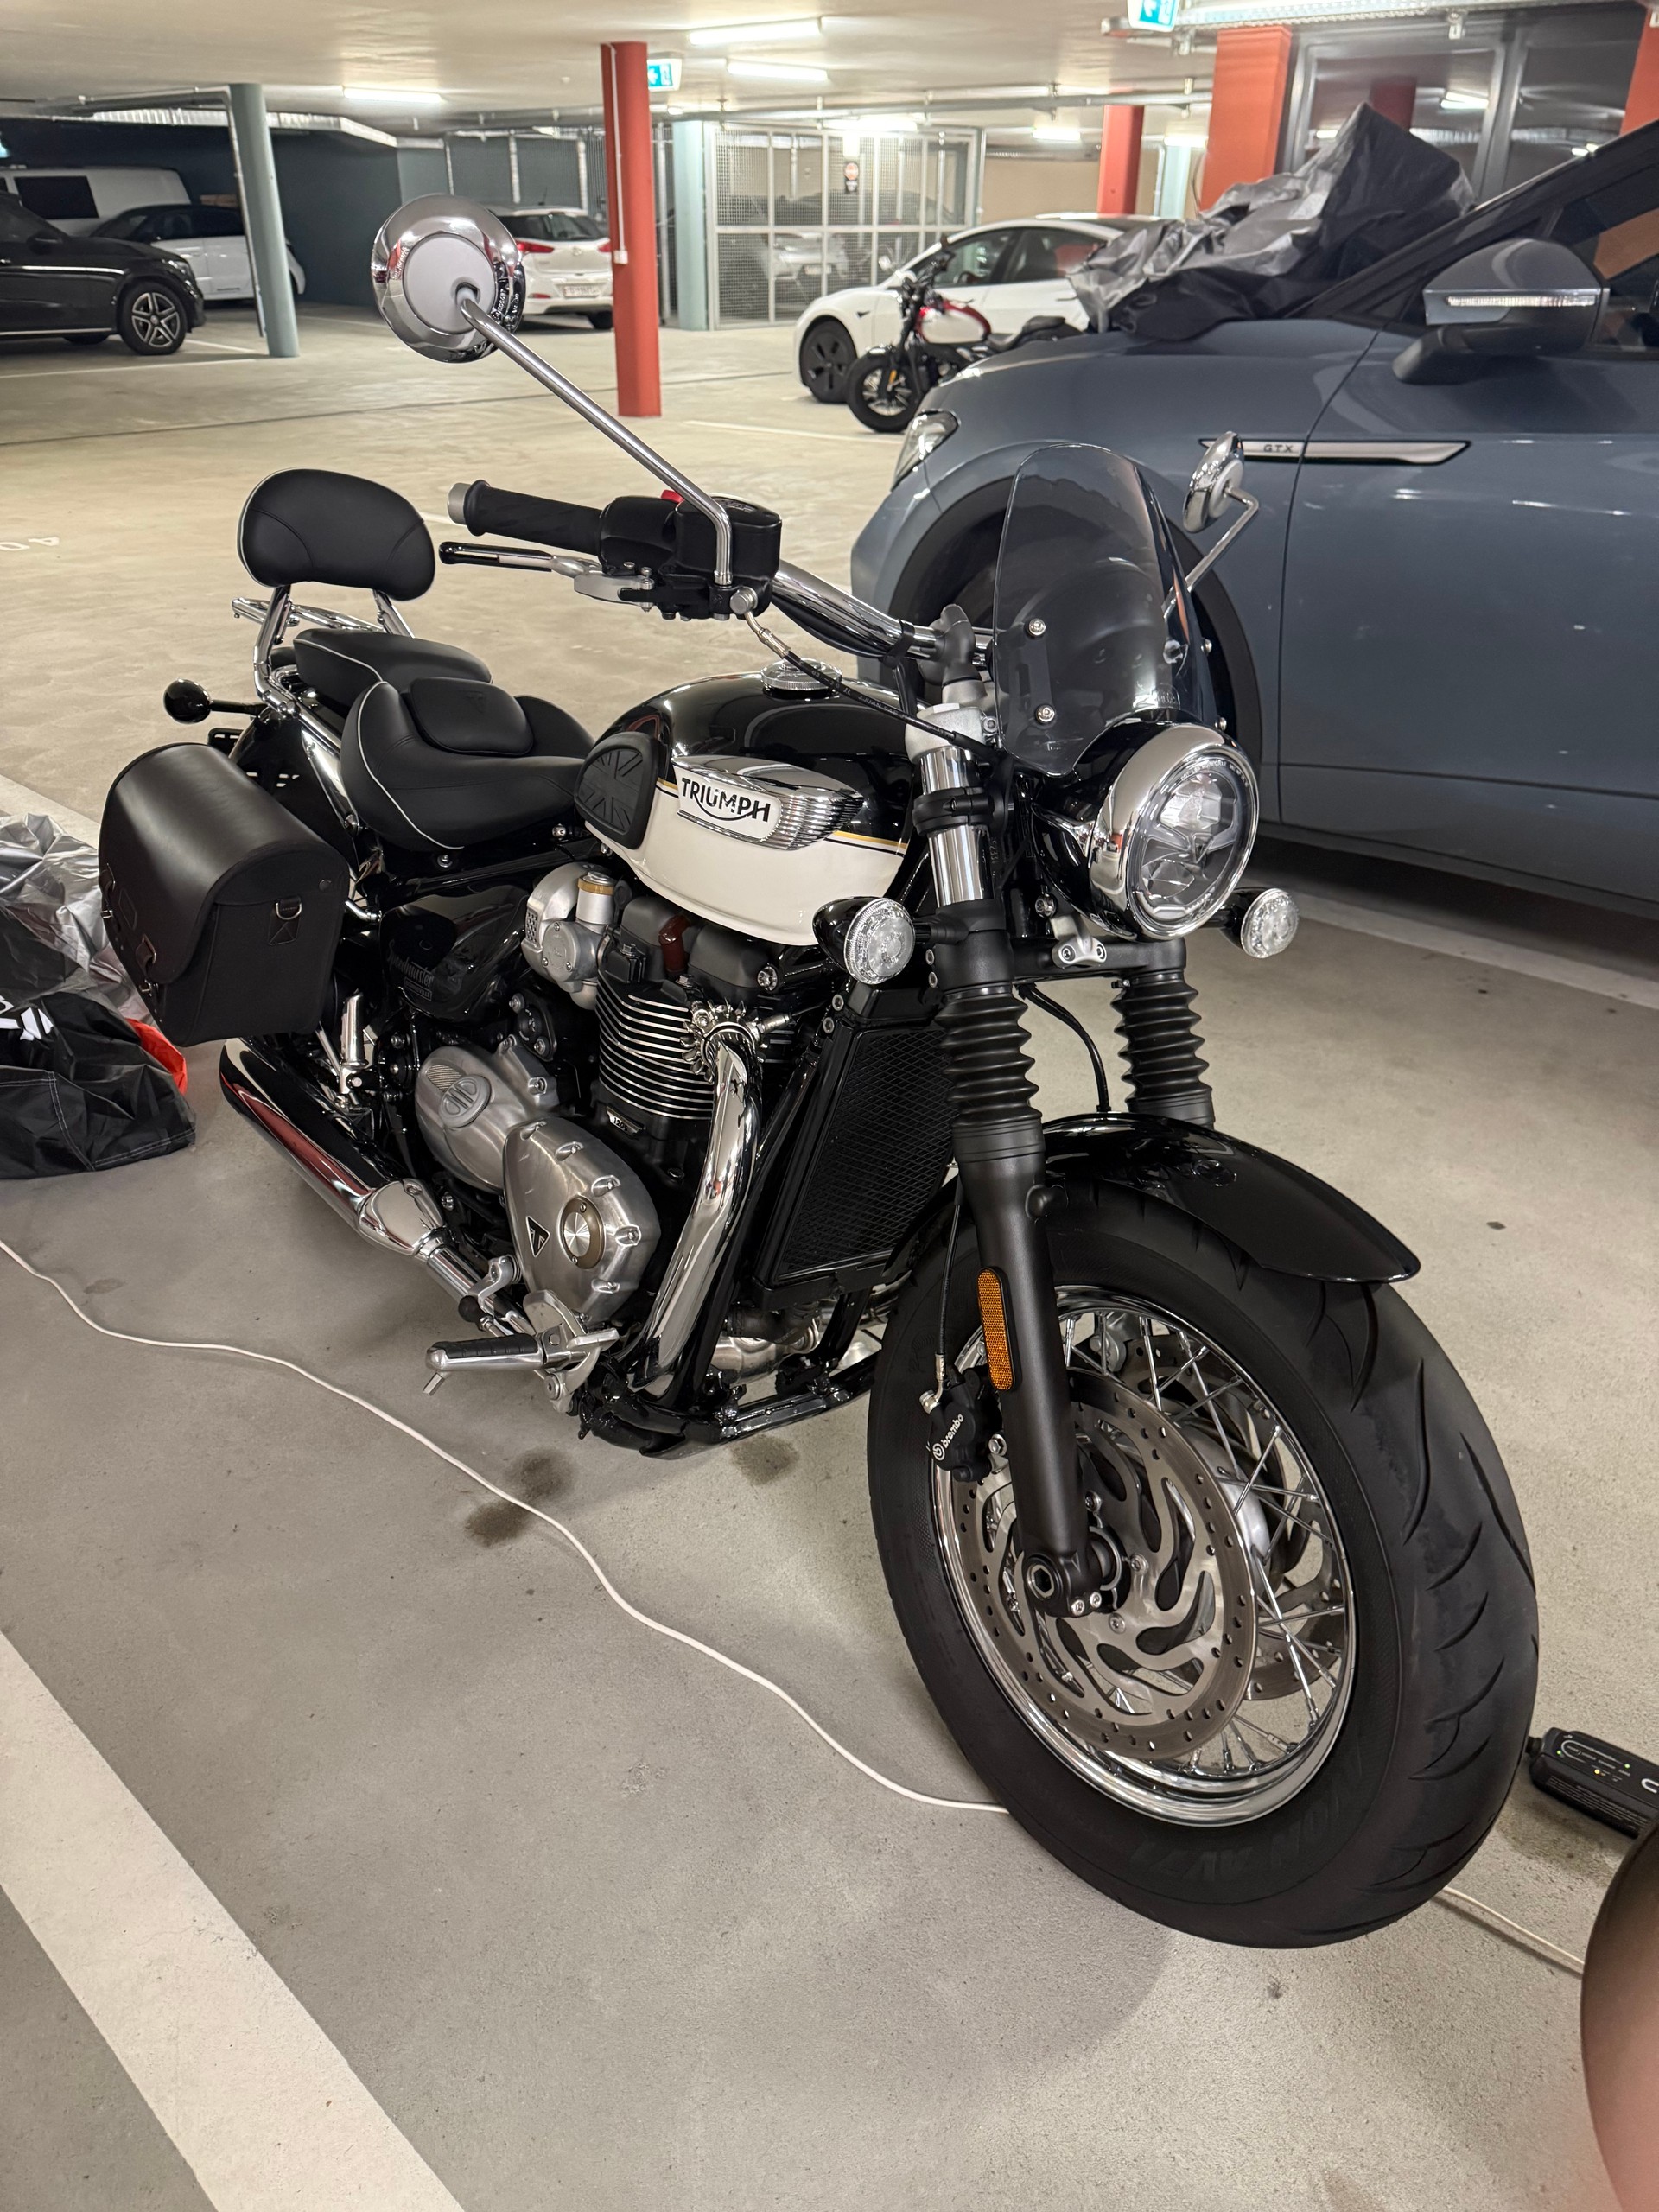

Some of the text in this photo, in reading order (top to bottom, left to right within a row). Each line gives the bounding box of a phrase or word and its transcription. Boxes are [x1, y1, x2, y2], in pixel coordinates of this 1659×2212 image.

[1263, 444, 1294, 453] GTX
[681, 777, 771, 822] TRIUMPH
[940, 1414, 964, 1449] brembo
